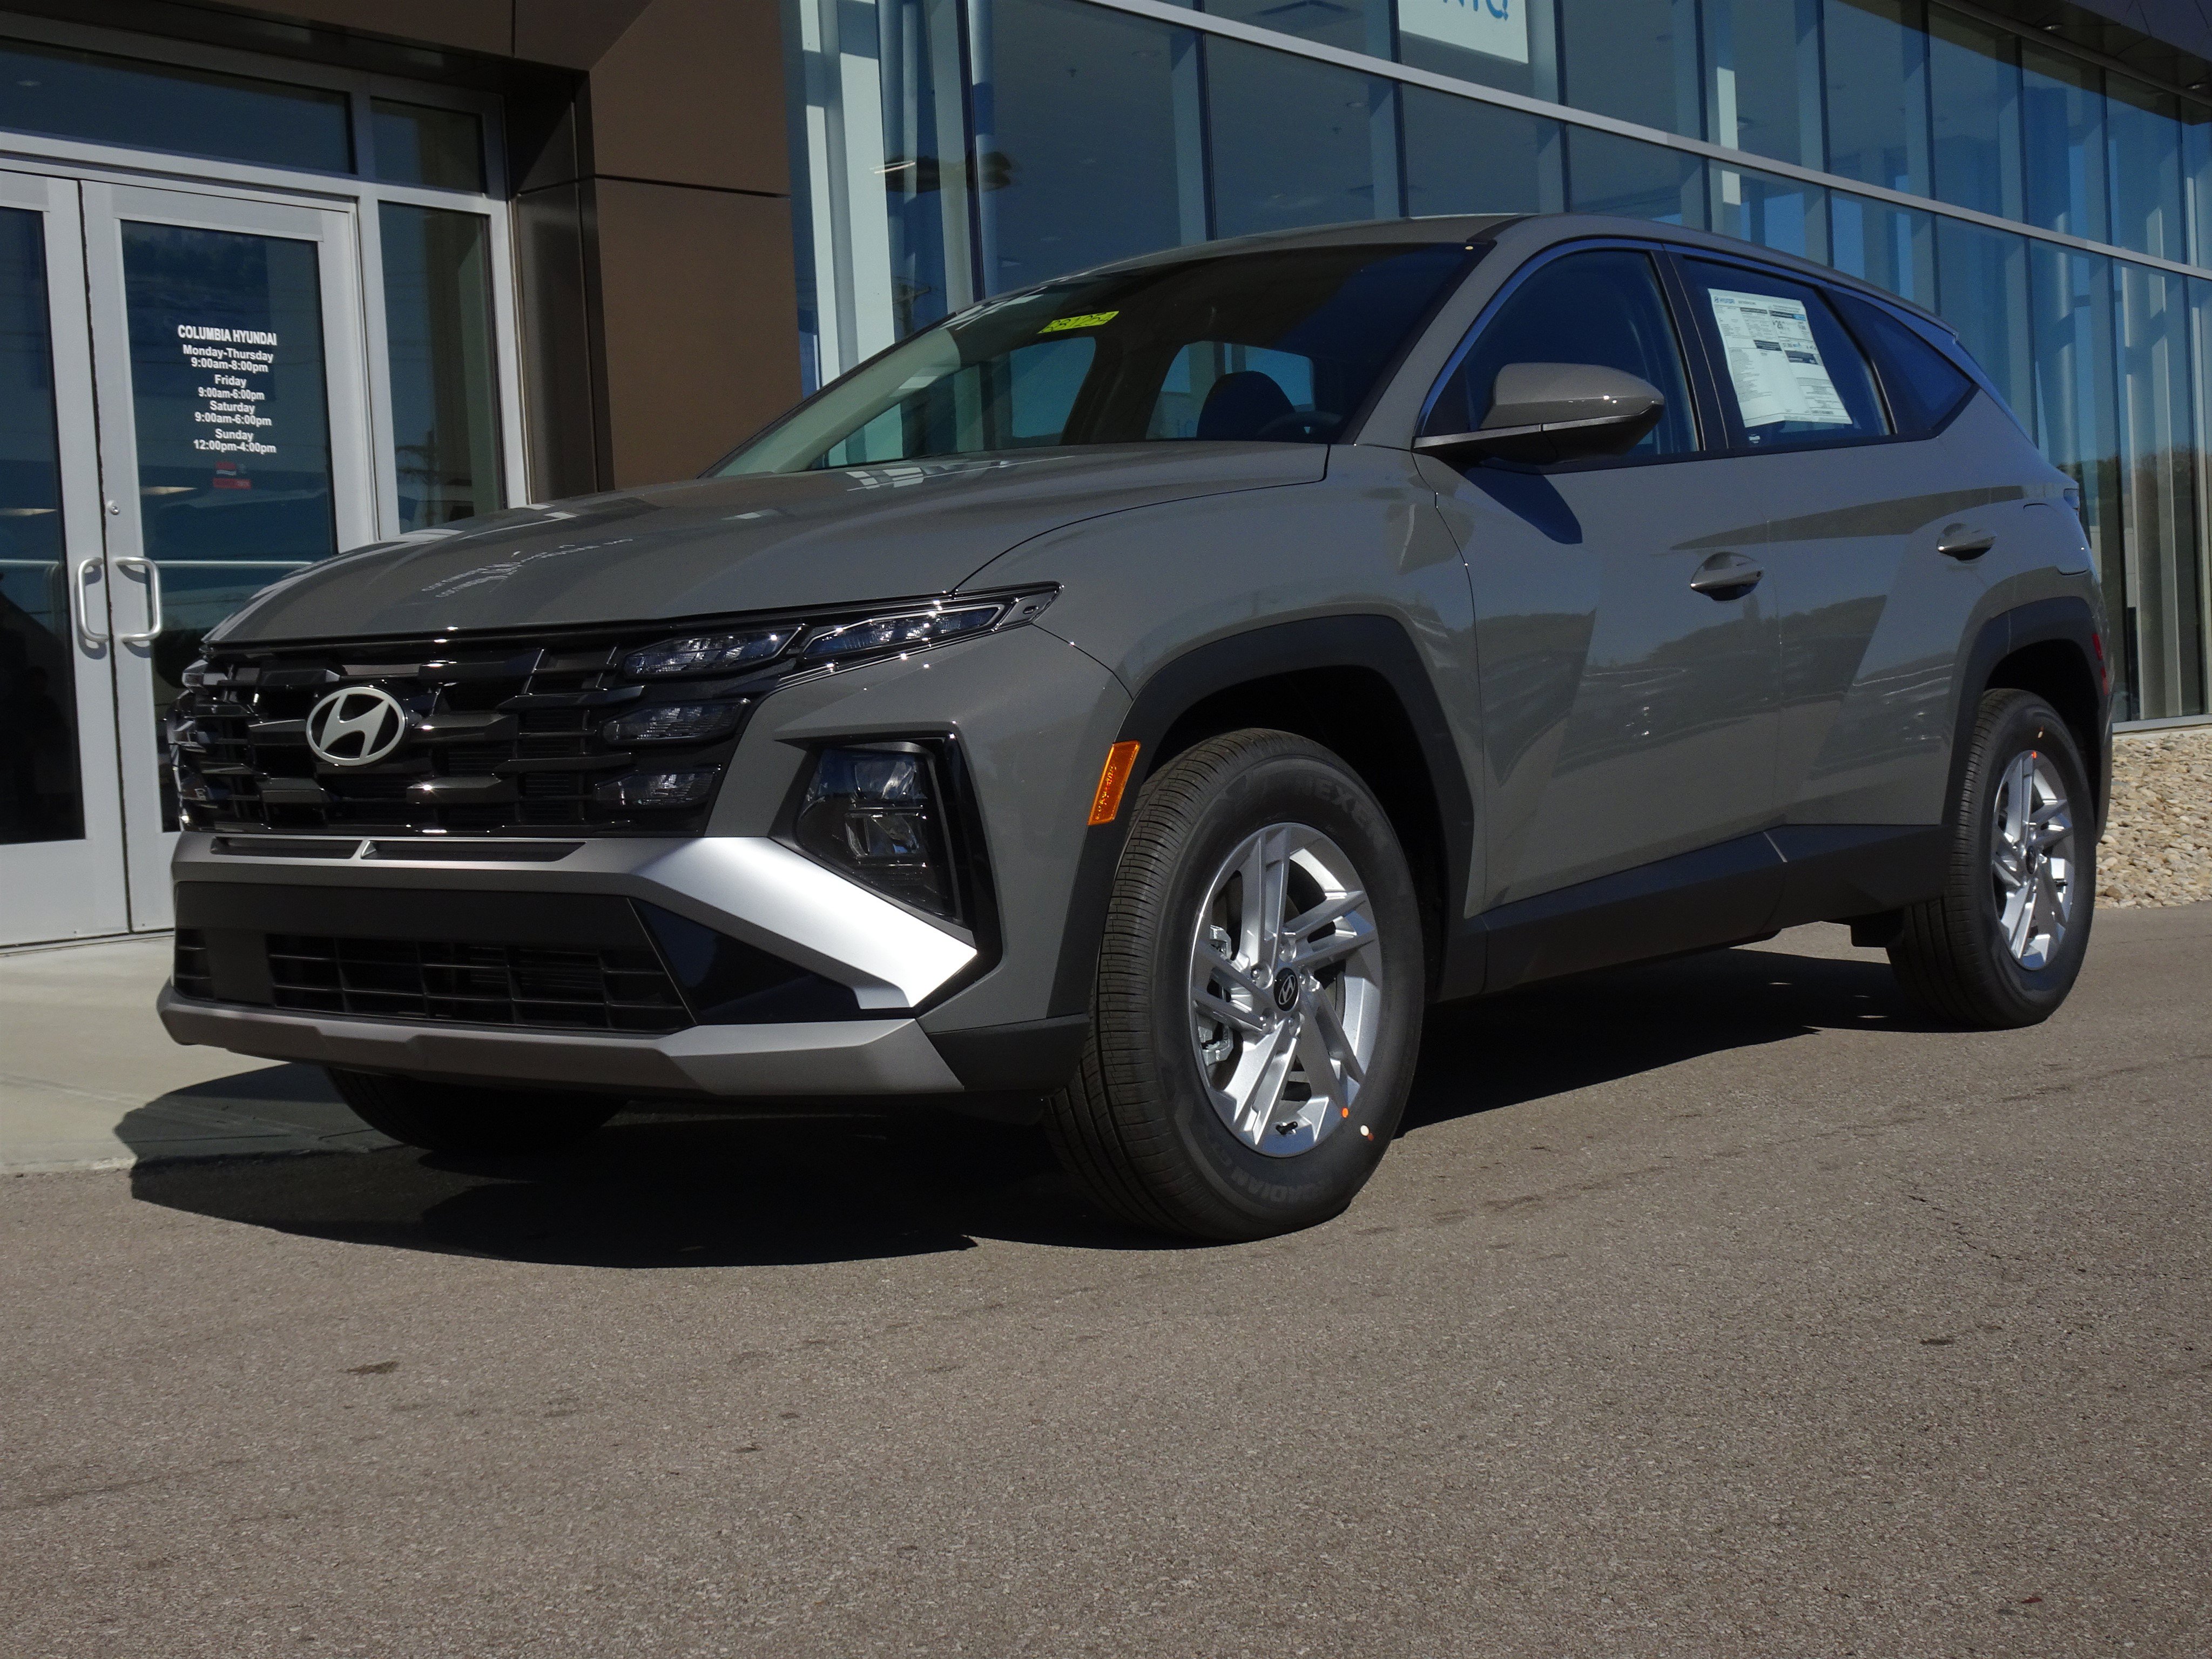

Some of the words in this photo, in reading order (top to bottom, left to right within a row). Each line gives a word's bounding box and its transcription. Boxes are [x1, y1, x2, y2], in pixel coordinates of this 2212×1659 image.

[178, 324, 232, 342] COLUMBIA
[232, 329, 278, 346] HYUNDAI
[183, 344, 274, 363] Monday-Thursday
[191, 357, 268, 374] 9:00am-8:00pm
[214, 374, 247, 388] Friday
[198, 387, 265, 401] 9:00am-6:00pm
[210, 400, 255, 415] Saturday
[194, 412, 272, 427] 9:00am-6:00pm
[215, 428, 254, 442] Sunday
[193, 439, 276, 454] 12:00pm-4:00pm
